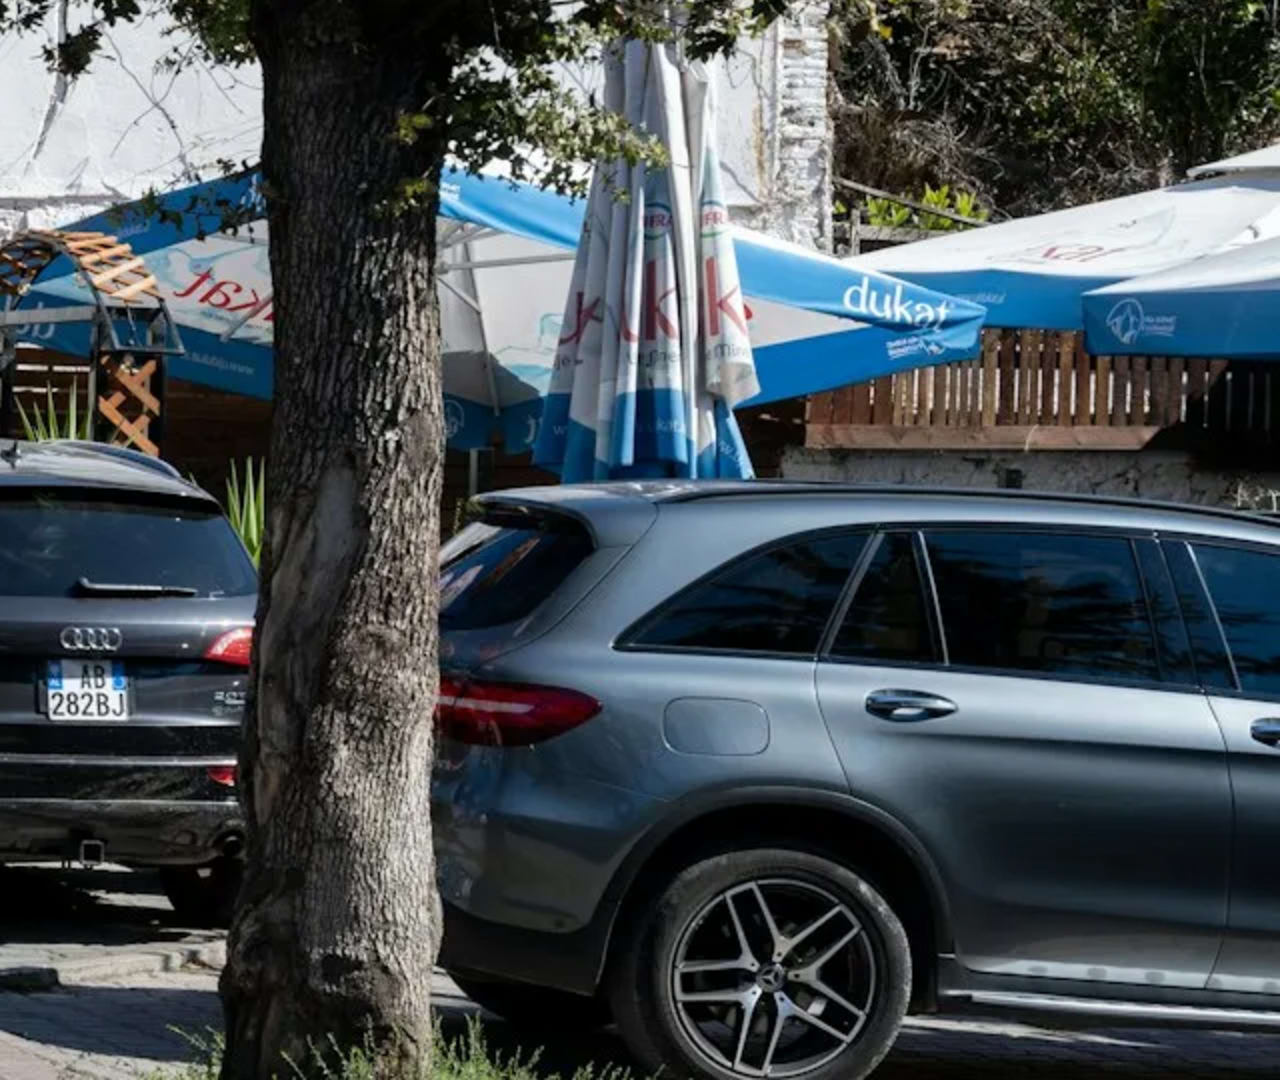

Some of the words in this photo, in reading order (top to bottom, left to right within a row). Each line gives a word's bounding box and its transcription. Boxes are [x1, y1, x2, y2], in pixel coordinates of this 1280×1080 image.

[842, 274, 951, 333] dukat
[80, 664, 106, 689] AB
[51, 692, 125, 716] 282BJ
